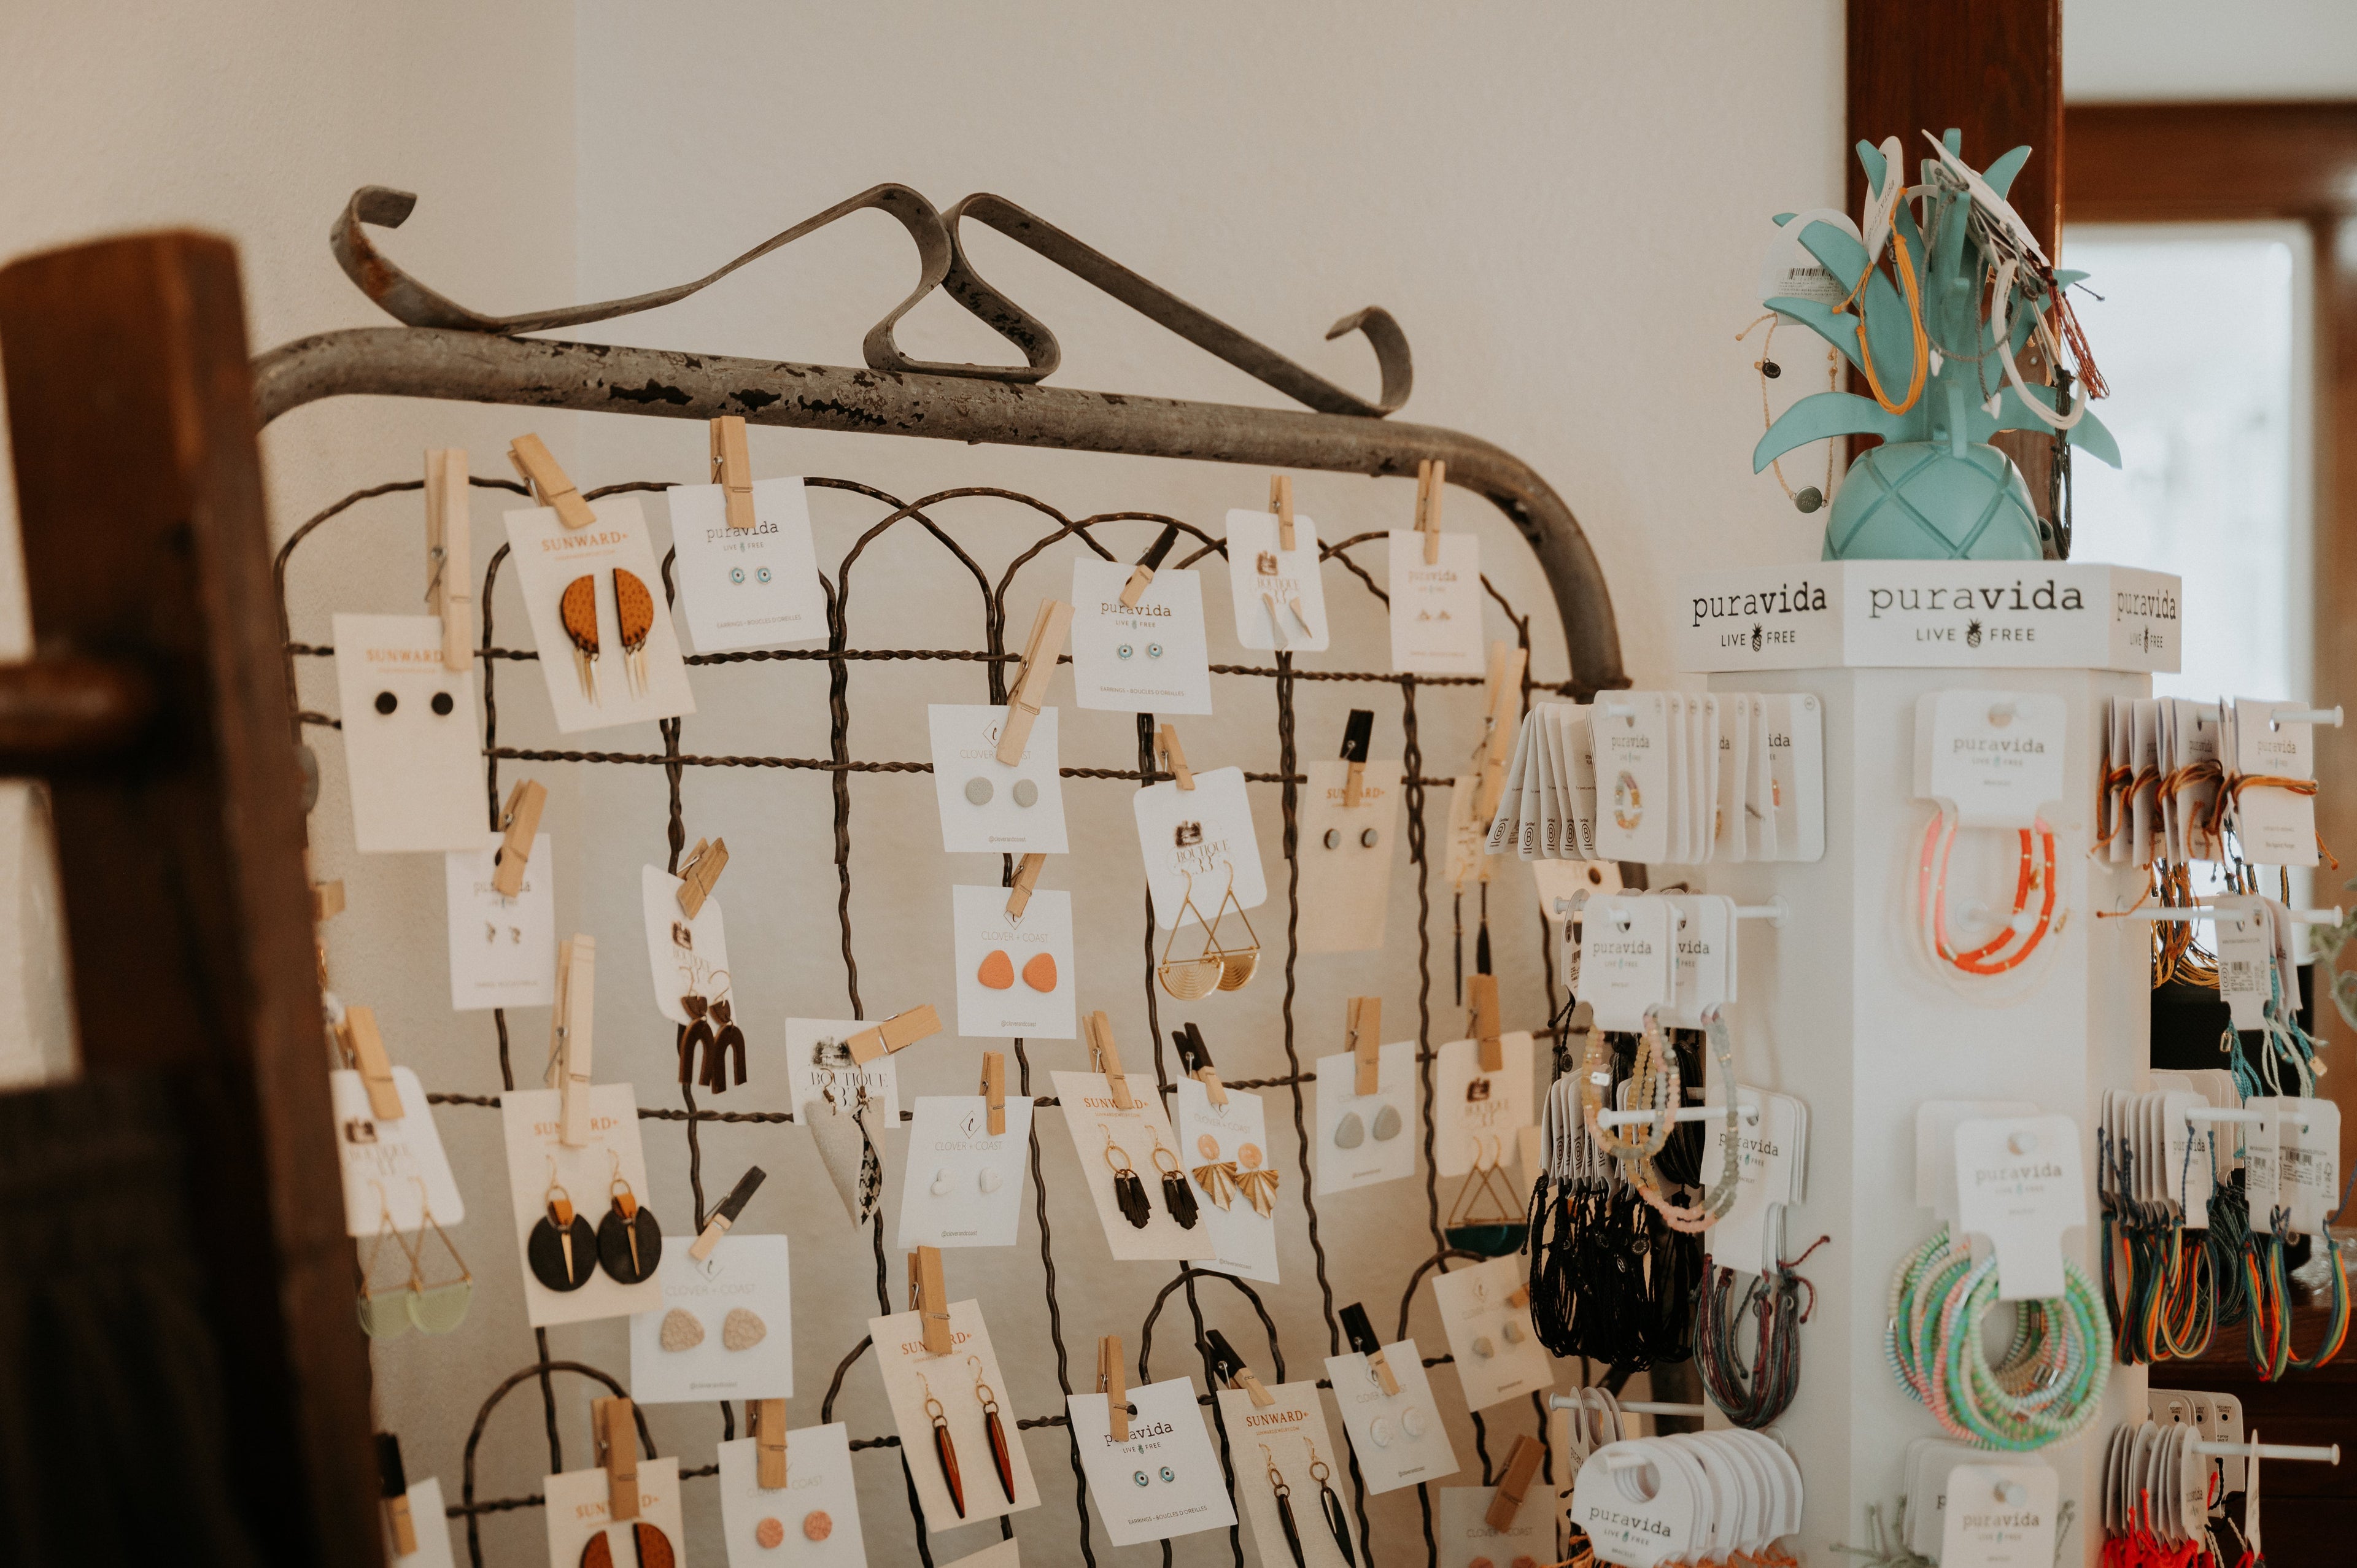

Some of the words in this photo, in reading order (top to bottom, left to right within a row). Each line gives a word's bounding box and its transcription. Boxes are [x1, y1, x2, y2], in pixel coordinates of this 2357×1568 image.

[706, 521, 779, 542] puravida
[541, 531, 621, 551] SUNWARD
[1692, 581, 1827, 627] puravida
[1870, 580, 2084, 619] puravida
[2117, 589, 2176, 622] puravida
[1101, 602, 1172, 617] puravida
[1720, 633, 1746, 647] LIVE
[1767, 630, 1795, 644] FREE
[1916, 628, 1956, 641] LIVE
[1991, 628, 2035, 641] FREE
[2130, 633, 2142, 646] LIVE
[2150, 635, 2163, 648] FREE
[1611, 734, 1649, 750] puravida
[1953, 738, 2045, 753] puravida
[959, 749, 994, 759] CLOVER
[1177, 839, 1229, 863] BOUTIQUE
[981, 930, 1013, 941] CLOVER
[1023, 933, 1049, 943] COAST
[1593, 940, 1651, 957] puravida
[811, 1072, 888, 1087] BOUTIQUE
[1084, 1098, 1143, 1108] SUNWD
[934, 1141, 967, 1151] CLOVER
[975, 1141, 1003, 1150] COAST
[1719, 1133, 1779, 1156] pravida
[1751, 1157, 1764, 1167] FREE
[1975, 1162, 2062, 1186] puravida
[902, 1332, 966, 1355] SUNRD
[1246, 1410, 1303, 1427] SUNWARD
[1104, 1422, 1174, 1446] pavida
[1145, 1442, 1161, 1451] FREE
[575, 1494, 652, 1519] SUND
[1128, 1516, 1152, 1525] EARRINGS
[1156, 1511, 1178, 1521] BOUCLES
[1179, 1505, 1207, 1516] D'OREILLES
[1589, 1507, 1671, 1537] puravida
[1963, 1513, 2040, 1530] puravida
[1604, 1529, 1620, 1538] LIVE
[1631, 1536, 1649, 1545] FREE
